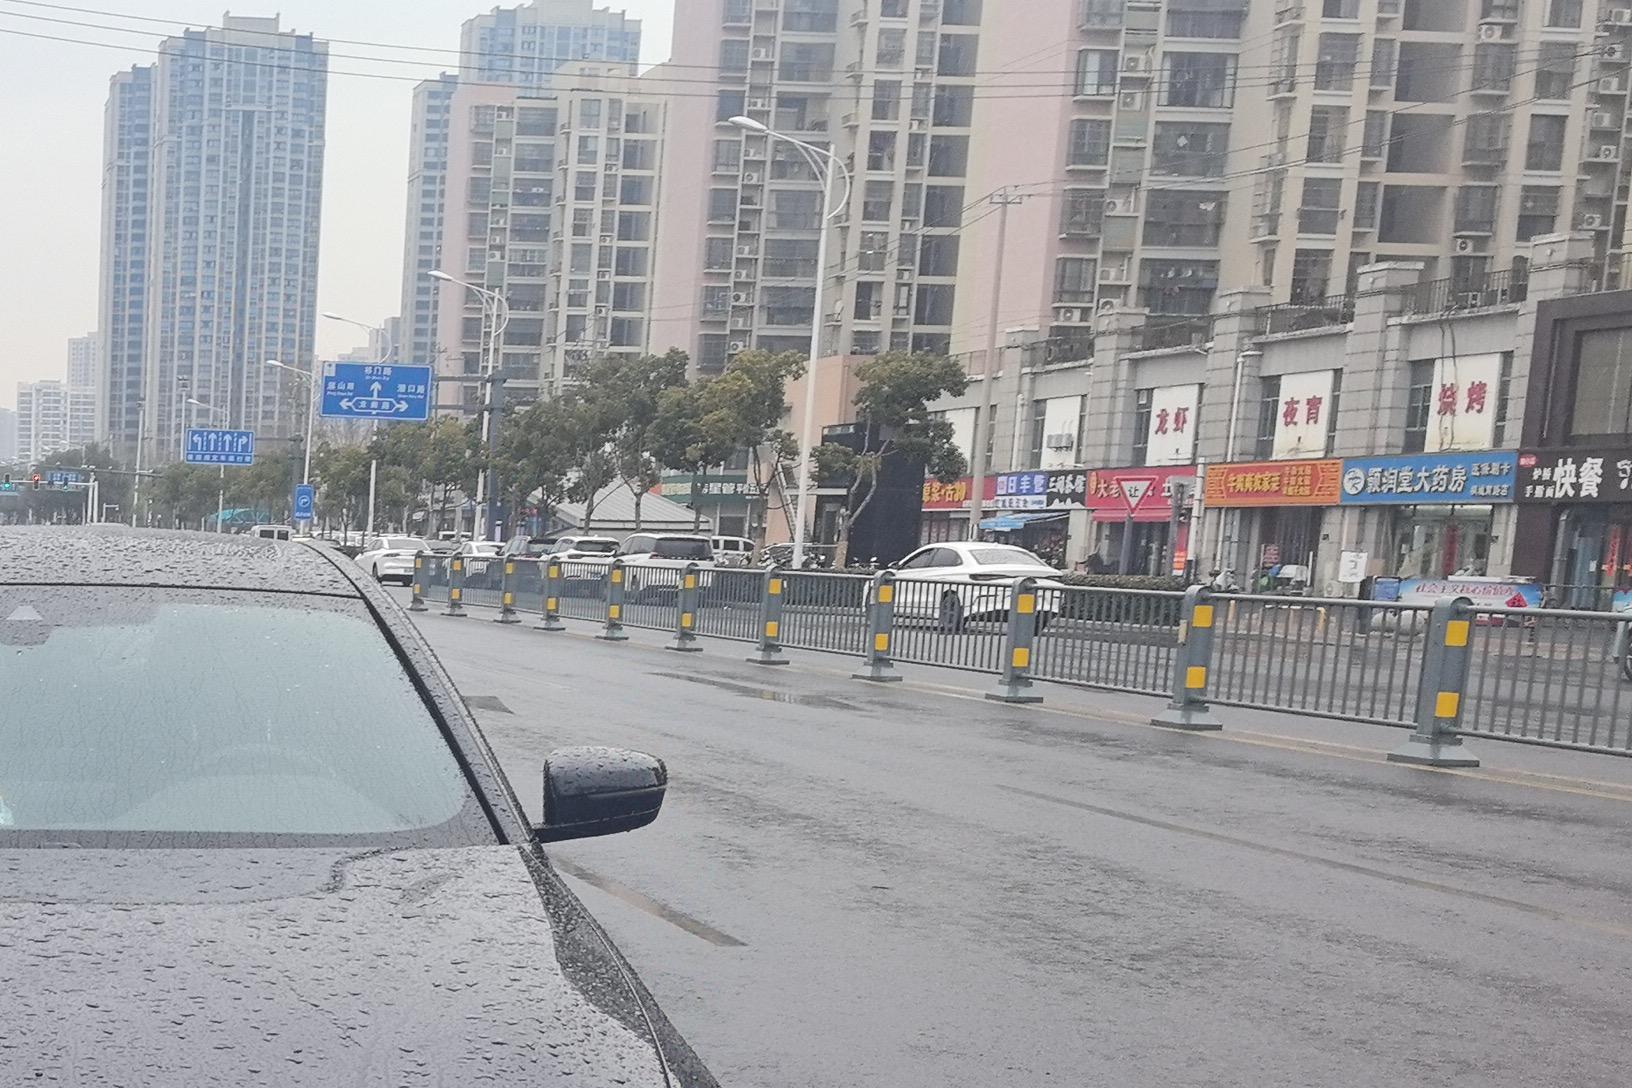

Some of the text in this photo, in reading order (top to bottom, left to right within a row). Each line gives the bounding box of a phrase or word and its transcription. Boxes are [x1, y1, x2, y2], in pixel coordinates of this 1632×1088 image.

[1282, 395, 1323, 427] 夜宵
[1437, 380, 1488, 416] 烧烤
[1154, 407, 1190, 436] 龙虾
[1127, 486, 1140, 498] 让
[1553, 457, 1604, 498] 快餐
